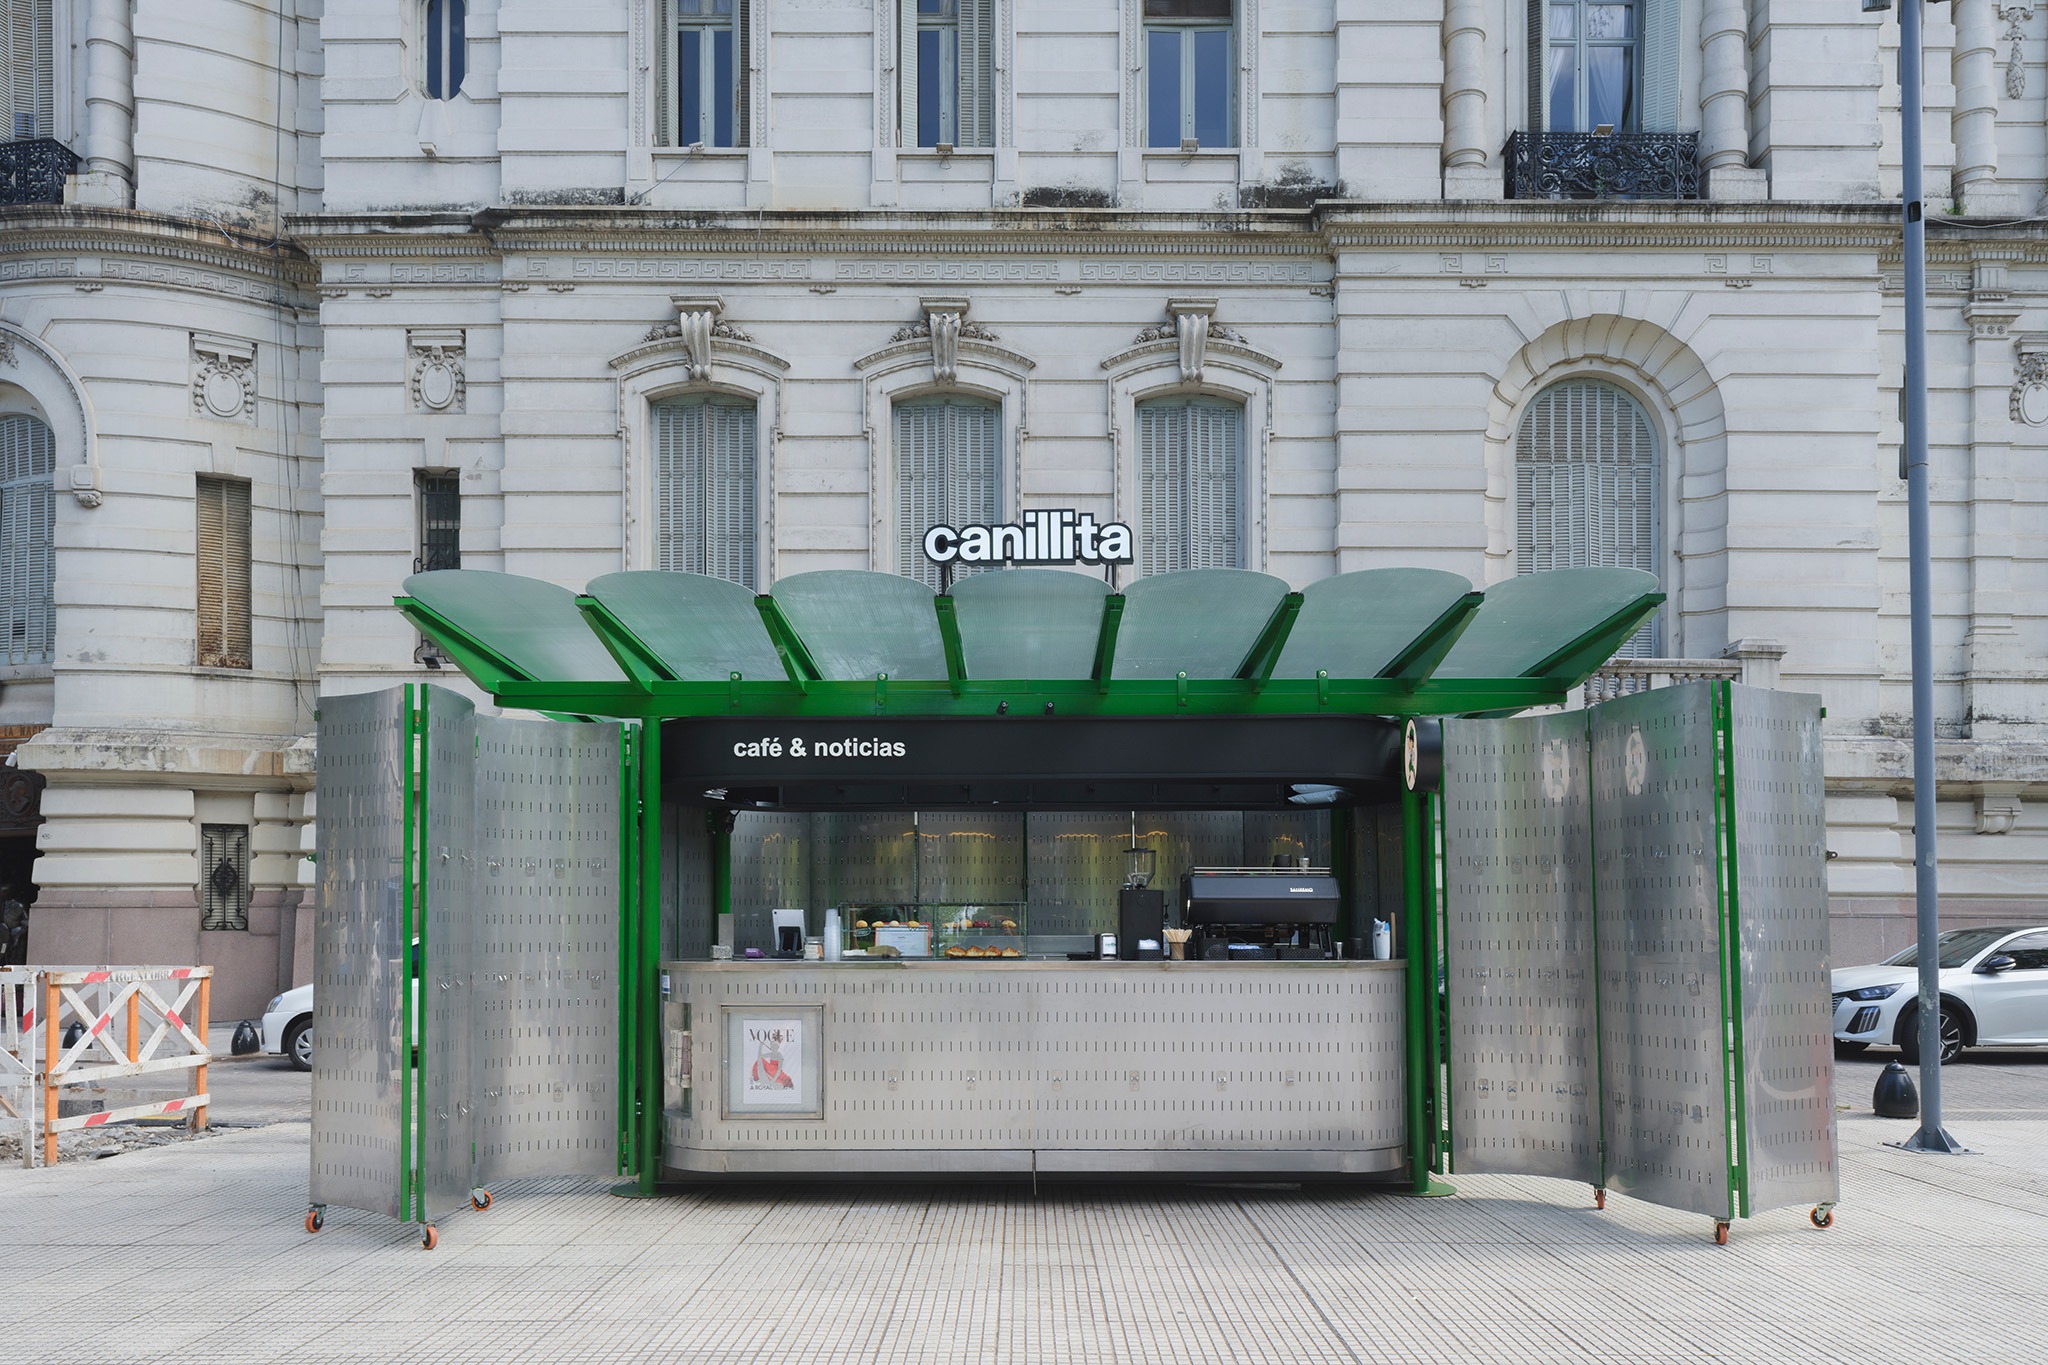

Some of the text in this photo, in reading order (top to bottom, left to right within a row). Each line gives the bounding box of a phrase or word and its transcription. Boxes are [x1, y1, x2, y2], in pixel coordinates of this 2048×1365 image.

[924, 510, 1132, 563] canillita
[733, 737, 906, 757] café & noticias
